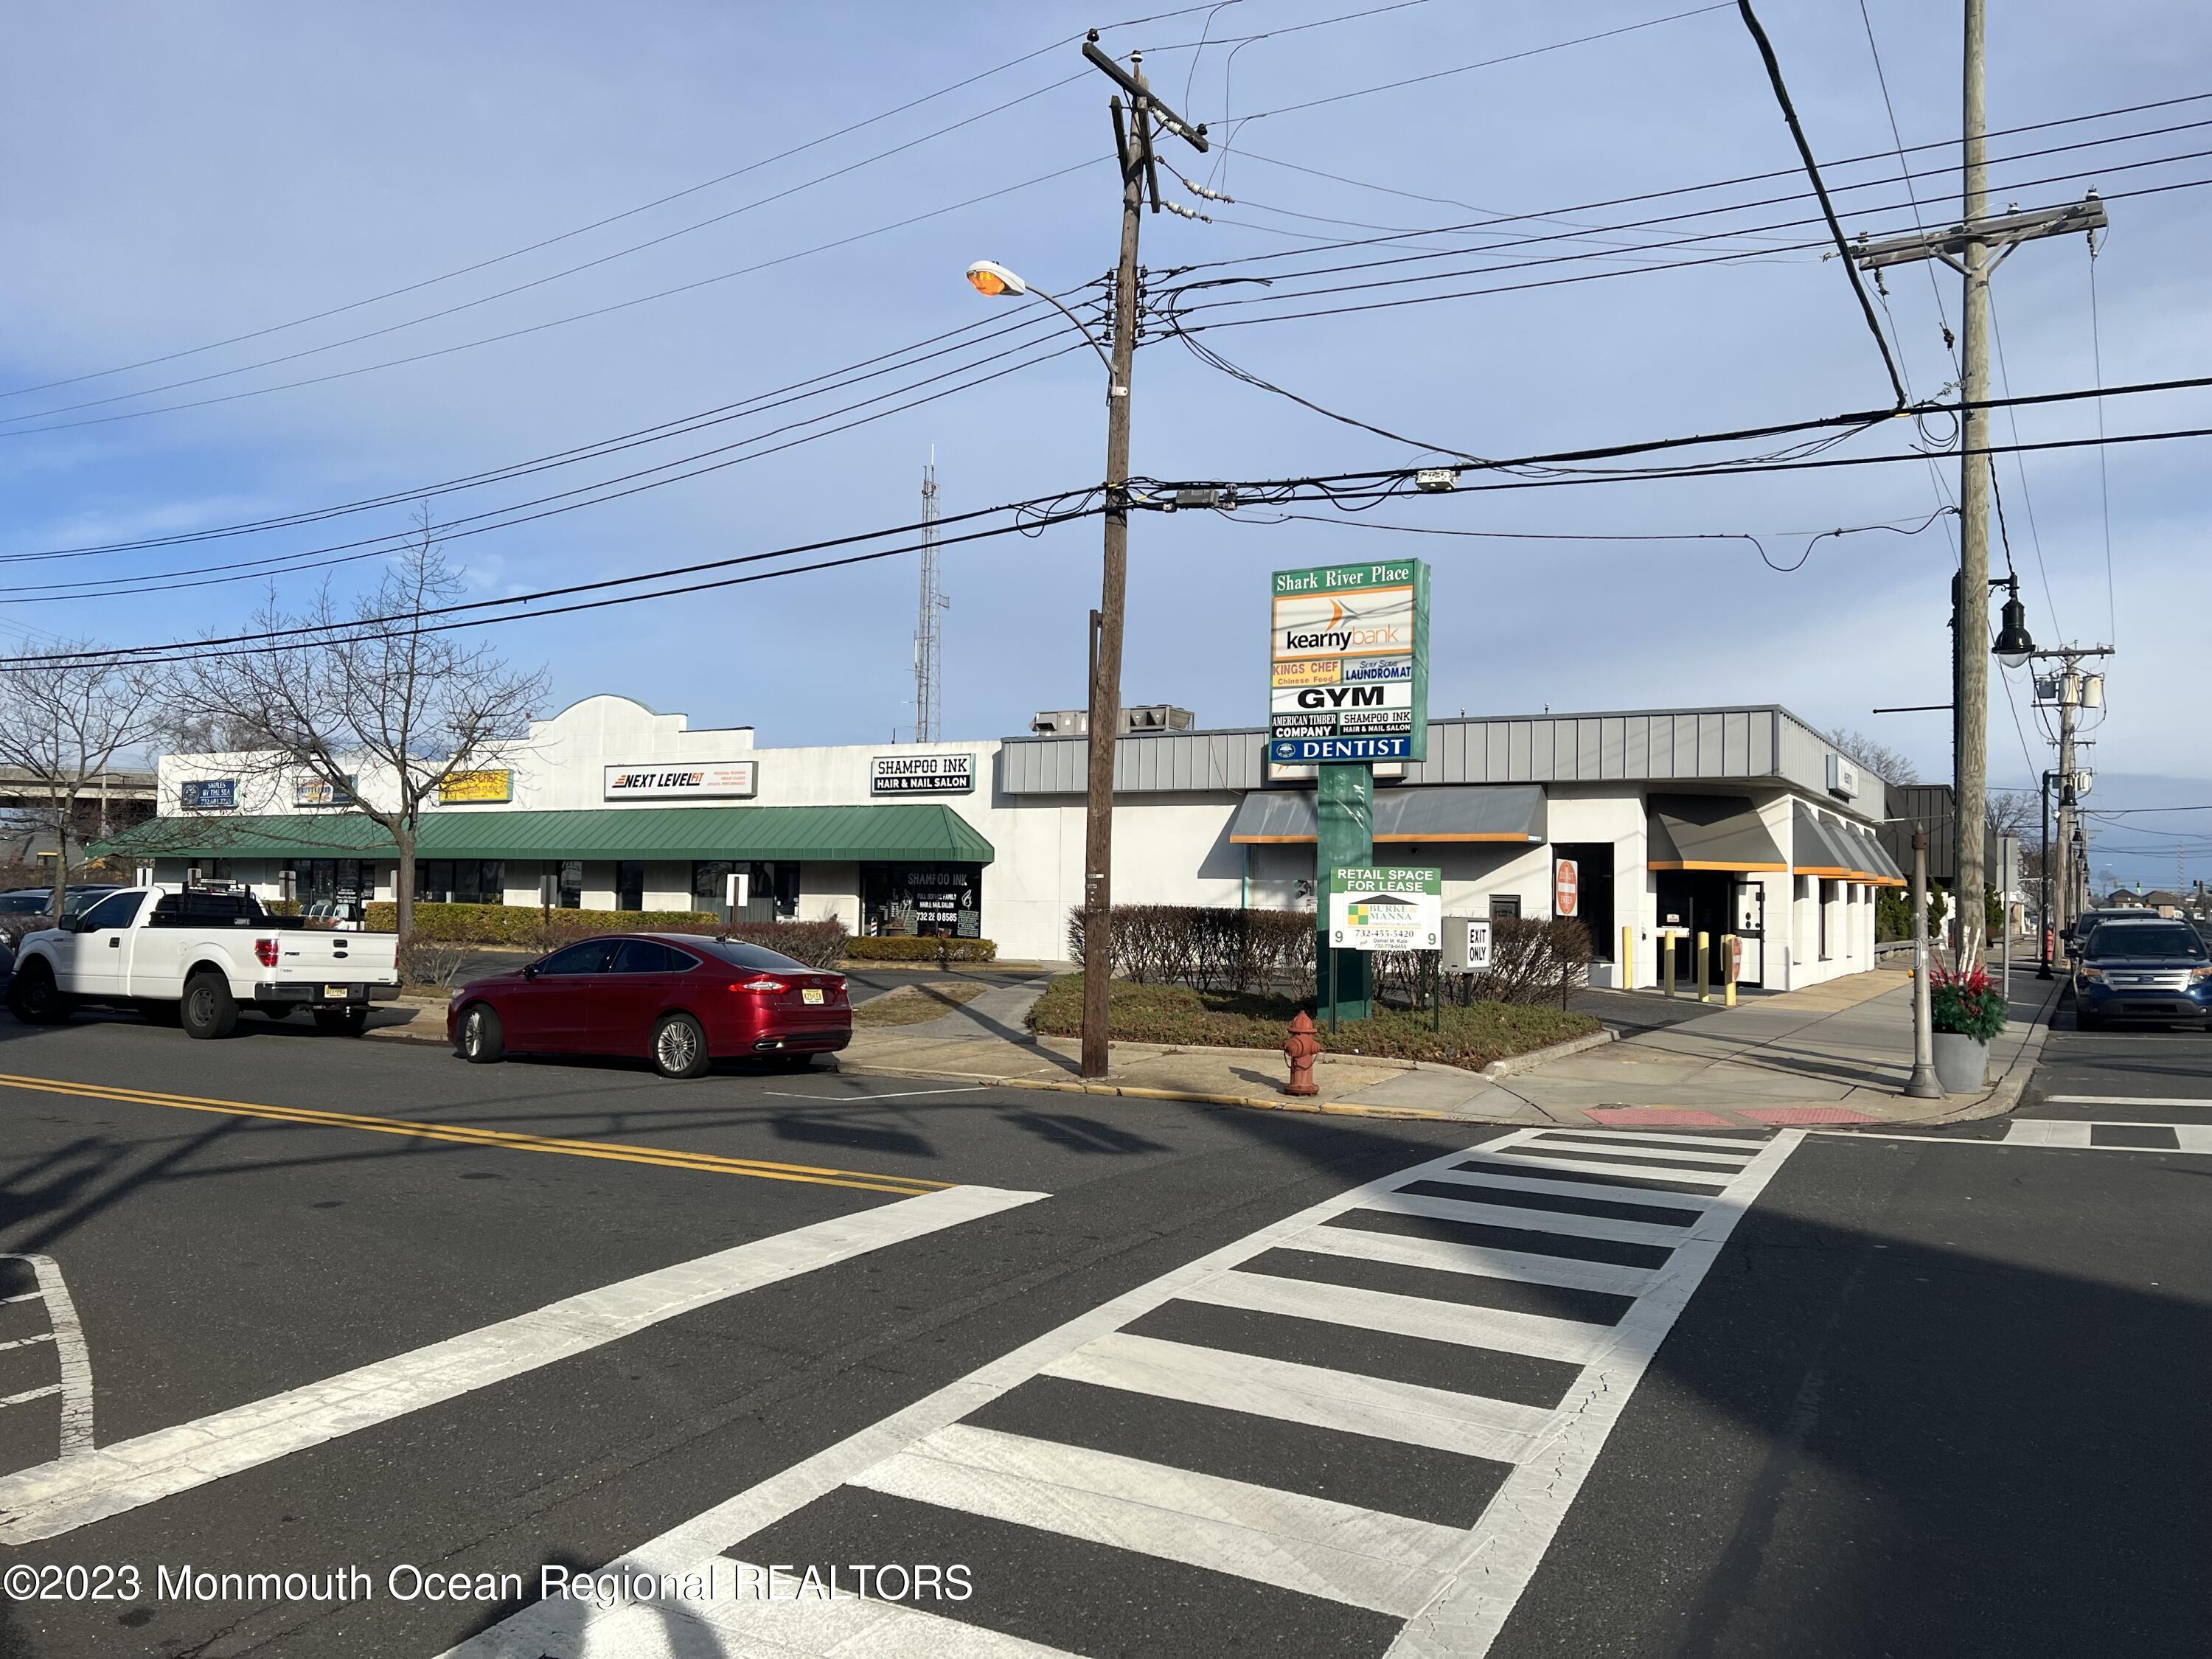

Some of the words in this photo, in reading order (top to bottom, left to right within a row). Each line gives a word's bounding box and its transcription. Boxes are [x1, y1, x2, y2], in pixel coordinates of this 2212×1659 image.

[1277, 571, 1318, 591] Shark
[1326, 569, 1363, 587] River
[1371, 566, 1409, 582] Place
[1273, 664, 1305, 675] KINGS
[1311, 661, 1338, 672] CHEF
[1346, 666, 1411, 681] LAUNDROMAT
[1278, 677, 1309, 685] Chinese
[1313, 675, 1333, 684] Food
[1297, 686, 1384, 709] GYM
[1272, 714, 1307, 726] AMERICAN
[1309, 713, 1336, 725] TIMBER
[1344, 712, 1388, 723] SHAMPOO
[1392, 712, 1411, 722] INK
[1276, 726, 1332, 737] COMPANY
[1303, 739, 1405, 758] DENTIST
[878, 759, 937, 774] SHAMPOO
[944, 758, 967, 773] INK
[626, 773, 657, 787] NEXT
[658, 773, 692, 787] LEVEL
[691, 772, 705, 782] FIT
[877, 779, 900, 788] HAIR
[901, 779, 908, 787] &
[911, 778, 932, 787] NAIL
[934, 776, 967, 787] SALON
[1338, 869, 1384, 880] RETAIL
[1388, 870, 1433, 880] SPACE
[1347, 881, 1374, 891] FOR
[1380, 881, 1423, 891] LEASE
[1409, 905, 1416, 914] &
[917, 912, 927, 921] 732
[942, 912, 957, 922] 8585
[1335, 931, 1343, 943] 9
[1355, 930, 1414, 938] 732-455-5420
[1428, 933, 1436, 945] 9
[1470, 929, 1486, 944] EXIT
[1470, 947, 1486, 961] ONLY
